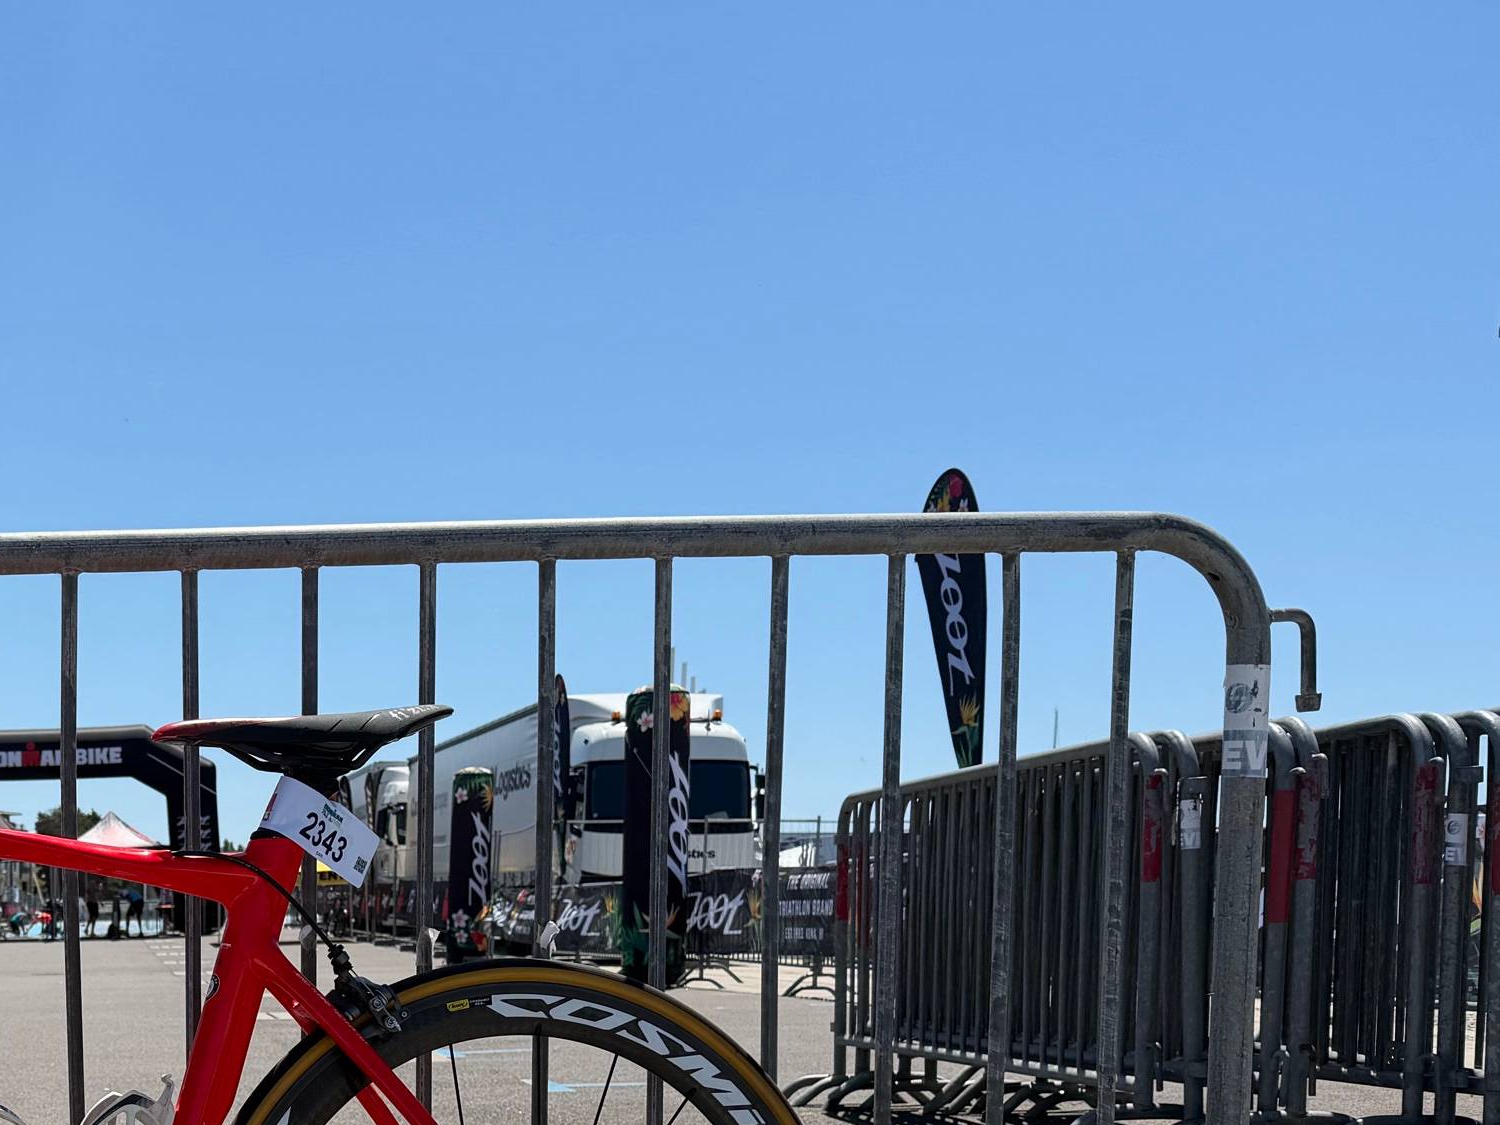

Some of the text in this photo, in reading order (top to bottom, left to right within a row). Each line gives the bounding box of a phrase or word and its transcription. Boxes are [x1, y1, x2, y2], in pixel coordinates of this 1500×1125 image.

[76, 746, 123, 766] BIKE
[299, 812, 348, 863] 2343
[787, 873, 830, 890] THE ORIGINAL
